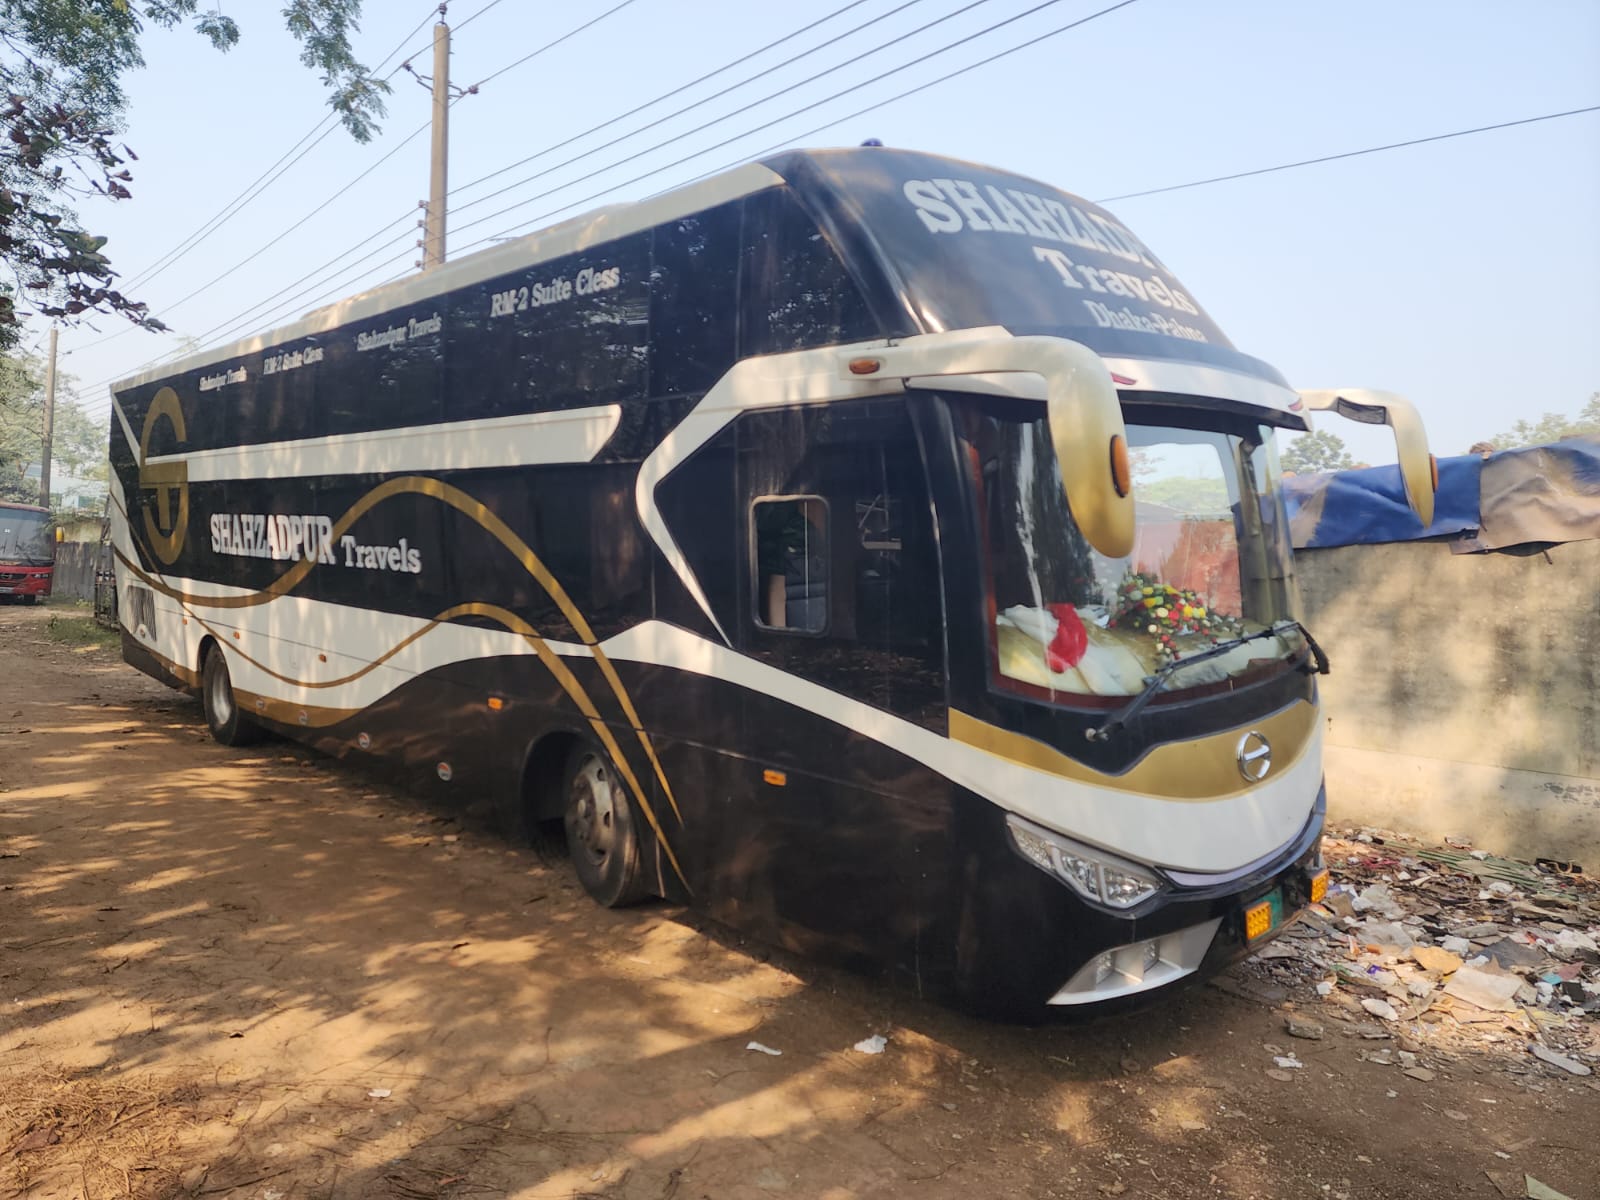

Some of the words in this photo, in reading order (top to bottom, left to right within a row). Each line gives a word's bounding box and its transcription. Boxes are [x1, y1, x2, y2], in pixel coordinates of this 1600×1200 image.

[903, 178, 1163, 271] SHAHZADP
[531, 275, 572, 308] Suite
[1032, 245, 1199, 316] Travels
[210, 513, 336, 565] SHAHZADPUR
[341, 535, 422, 574] Travels
